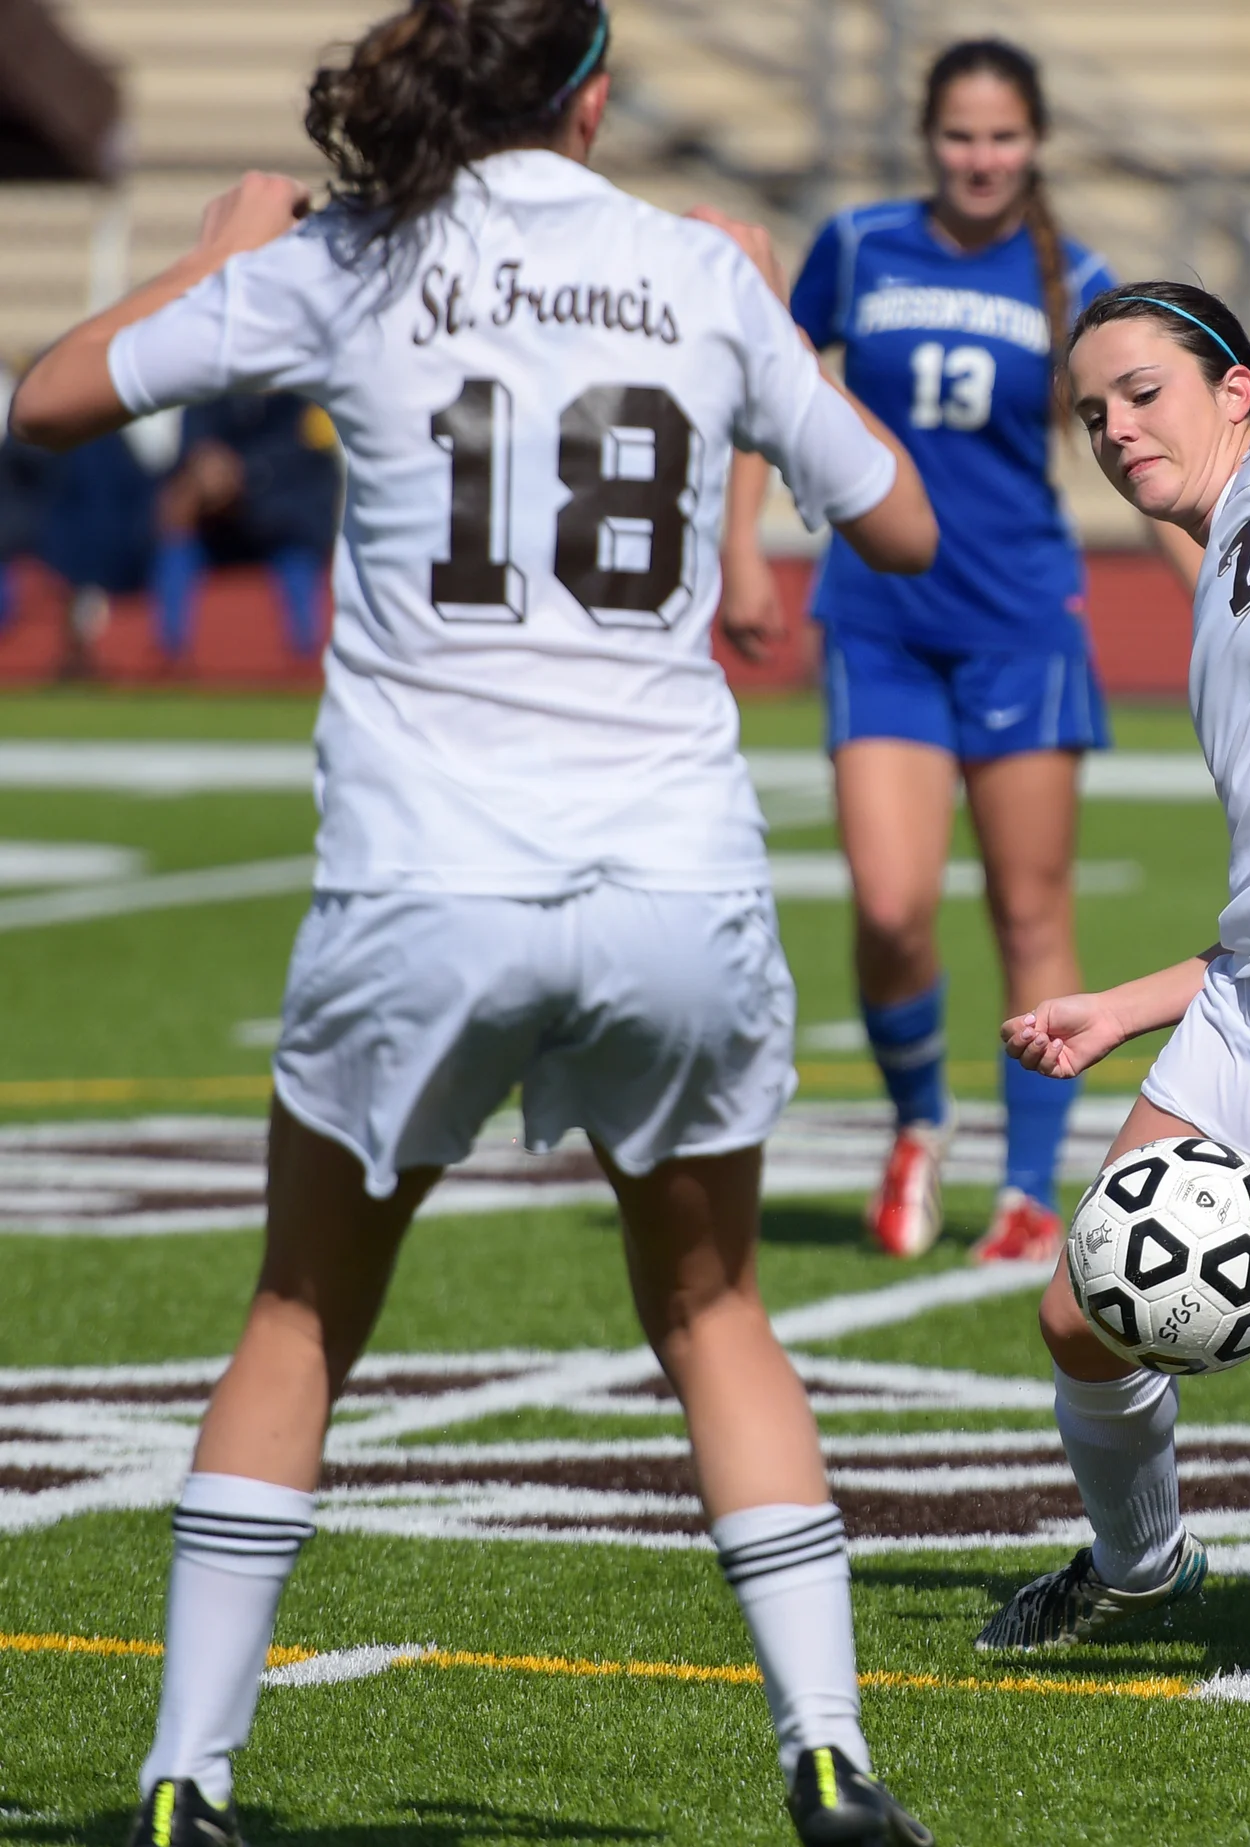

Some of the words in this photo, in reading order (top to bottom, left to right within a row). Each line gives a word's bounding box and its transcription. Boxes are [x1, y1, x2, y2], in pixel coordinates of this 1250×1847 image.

[413, 264, 477, 346] St.
[491, 259, 680, 345] Francis
[909, 341, 997, 431] 13
[431, 375, 706, 630] 18
[1159, 1294, 1201, 1344] SFGS
